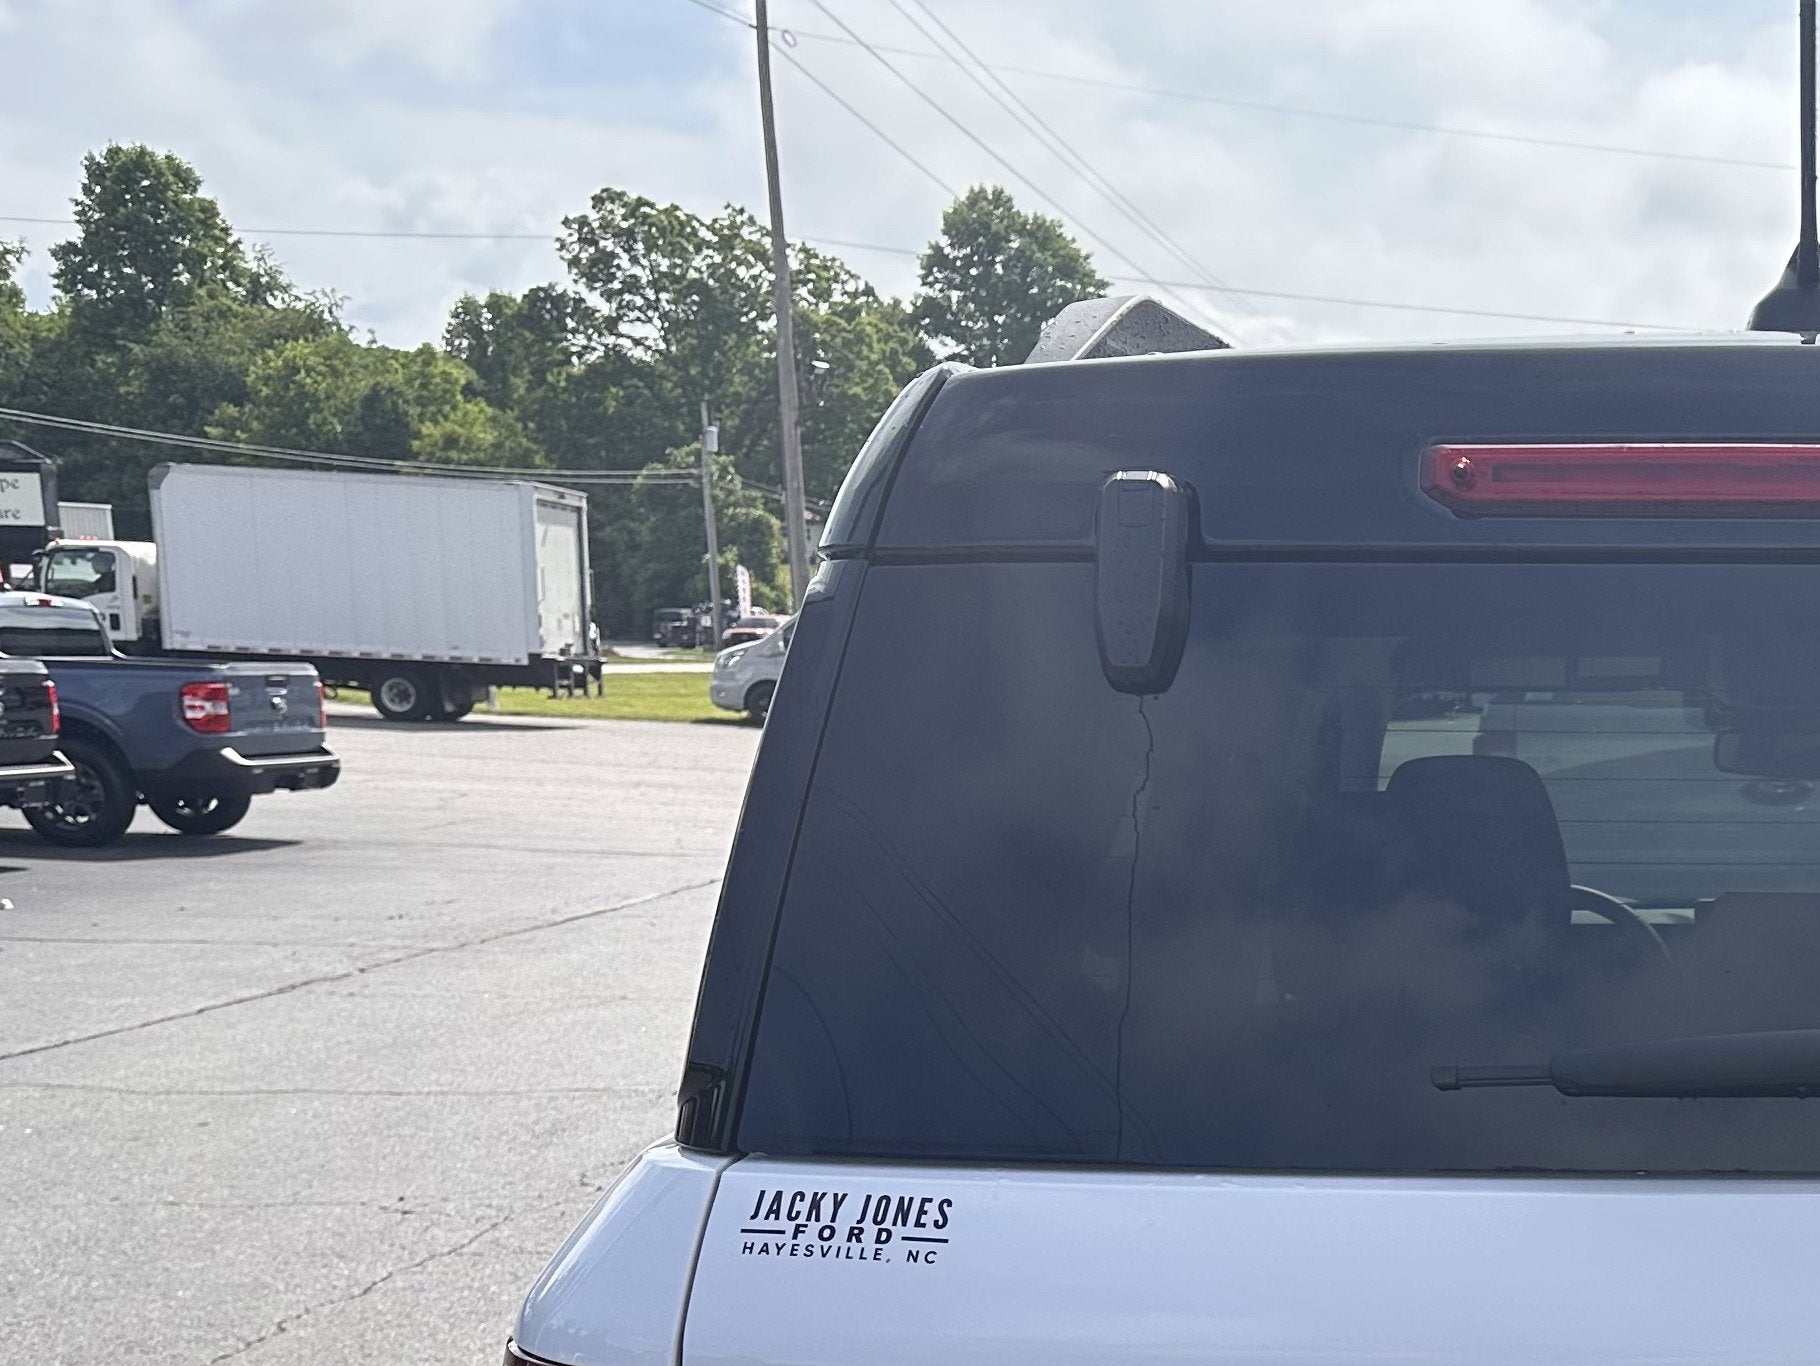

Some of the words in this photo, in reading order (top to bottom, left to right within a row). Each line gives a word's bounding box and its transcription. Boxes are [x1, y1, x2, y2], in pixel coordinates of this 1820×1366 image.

[749, 1189, 849, 1224] JACKY
[856, 1194, 953, 1230] JONES
[791, 1223, 893, 1245] FORD
[741, 1241, 892, 1264] HAYESVILLE,
[905, 1250, 938, 1265] NC
